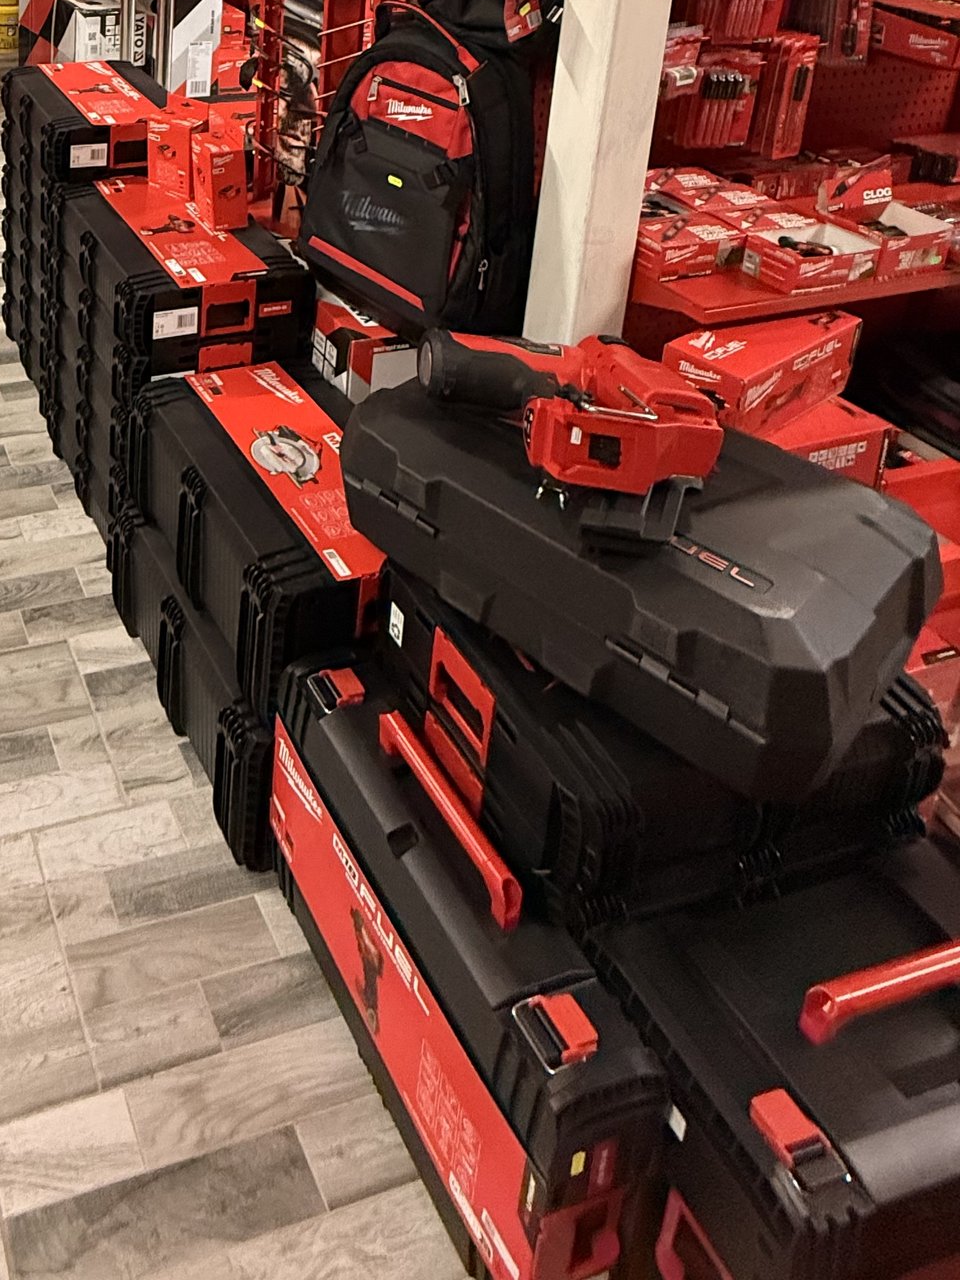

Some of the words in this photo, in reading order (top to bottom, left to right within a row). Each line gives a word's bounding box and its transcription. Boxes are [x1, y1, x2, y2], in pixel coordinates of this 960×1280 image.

[134, 16, 145, 48] YATO
[385, 98, 433, 115] Milwaukee
[863, 187, 892, 200] CLOG
[807, 339, 842, 362] FUEL
[253, 368, 305, 404] Milwaukee
[677, 360, 722, 380] Milwaukee
[745, 370, 783, 407] Milwaukee
[669, 535, 754, 588] UEL
[278, 737, 323, 820] Milwaukee
[360, 883, 430, 1017] FUEL
